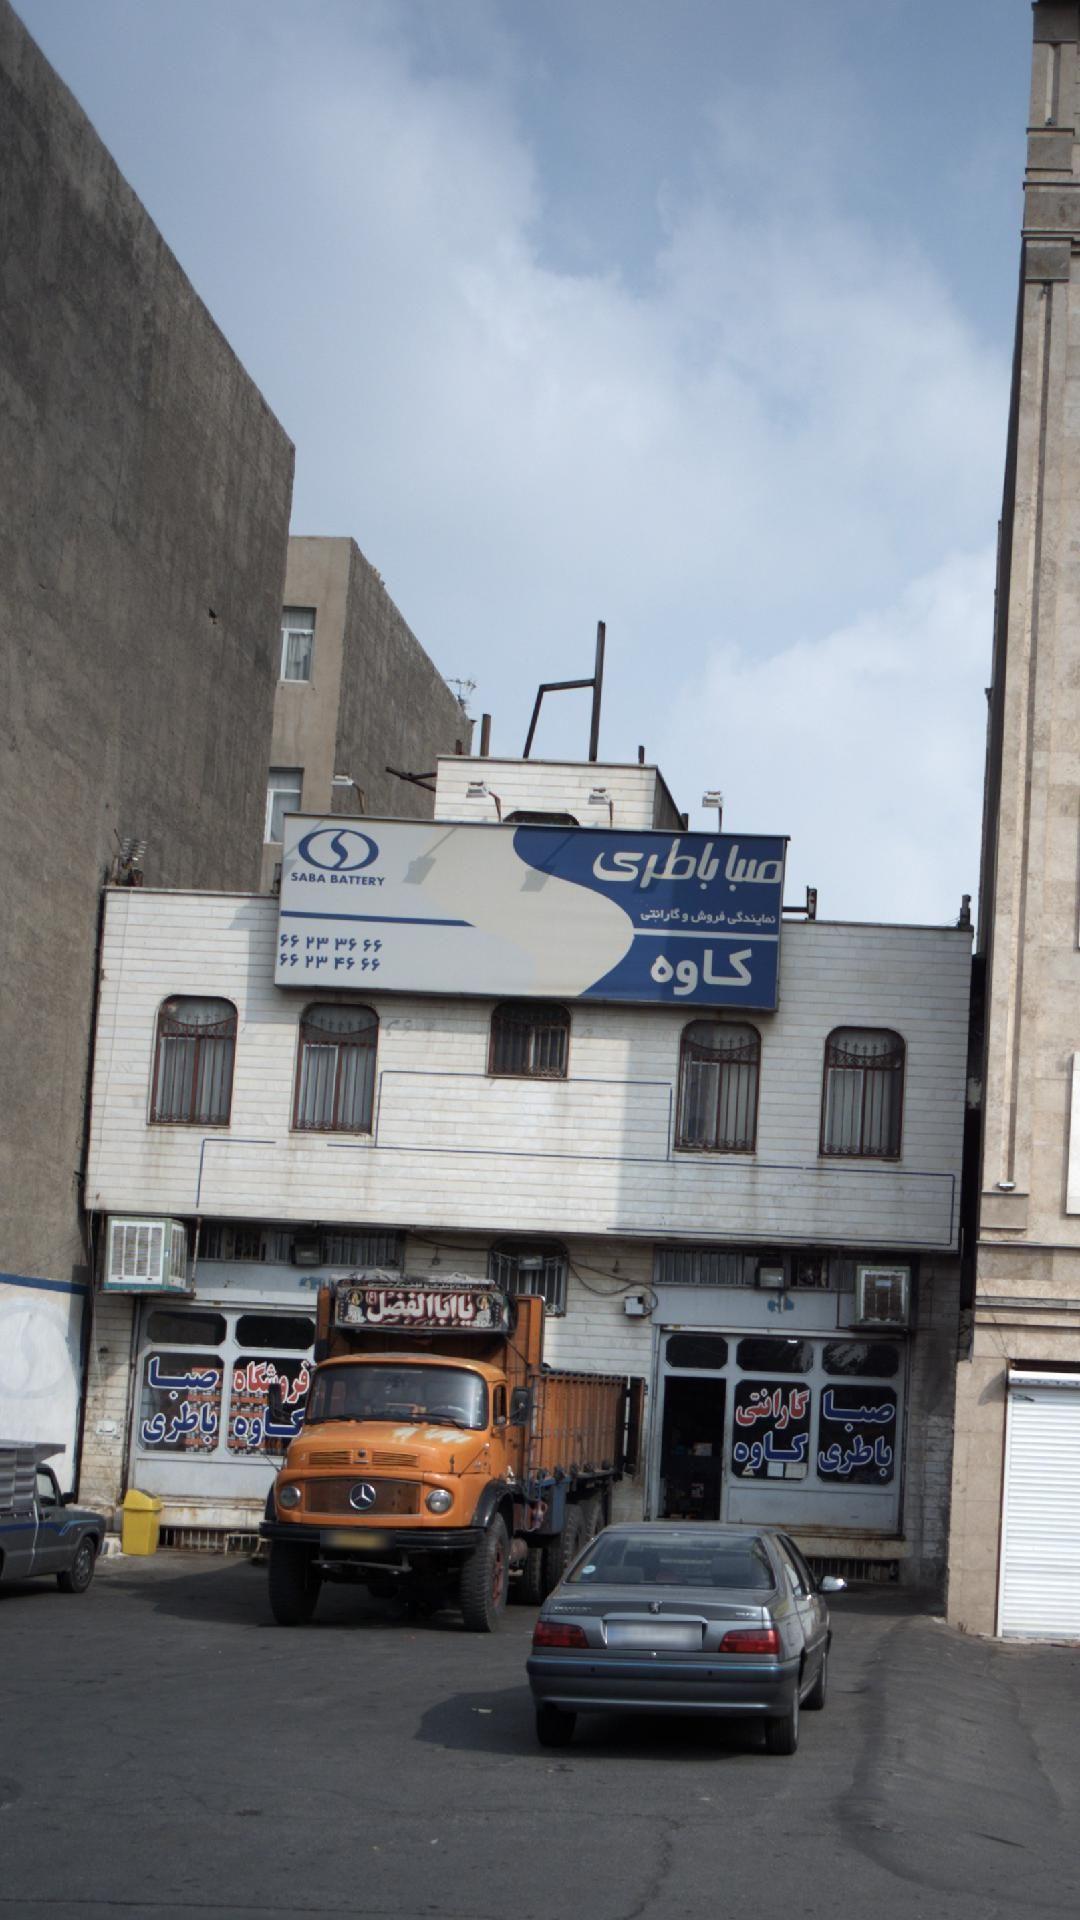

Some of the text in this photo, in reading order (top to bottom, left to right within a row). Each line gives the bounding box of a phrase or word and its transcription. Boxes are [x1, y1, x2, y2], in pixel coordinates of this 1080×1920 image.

[291, 872, 386, 886] SABA BATTERY
[592, 838, 784, 892] صبا باطری
[639, 907, 776, 927] نمایندگی فروش و گارانتی
[651, 948, 752, 996] کاوه
[148, 1355, 220, 1400] صبا
[141, 1400, 218, 1445] باطری
[735, 1388, 810, 1429] گارانتی
[822, 1390, 895, 1432] صبا
[733, 1430, 809, 1469] کاوه
[818, 1434, 893, 1477] باطری
